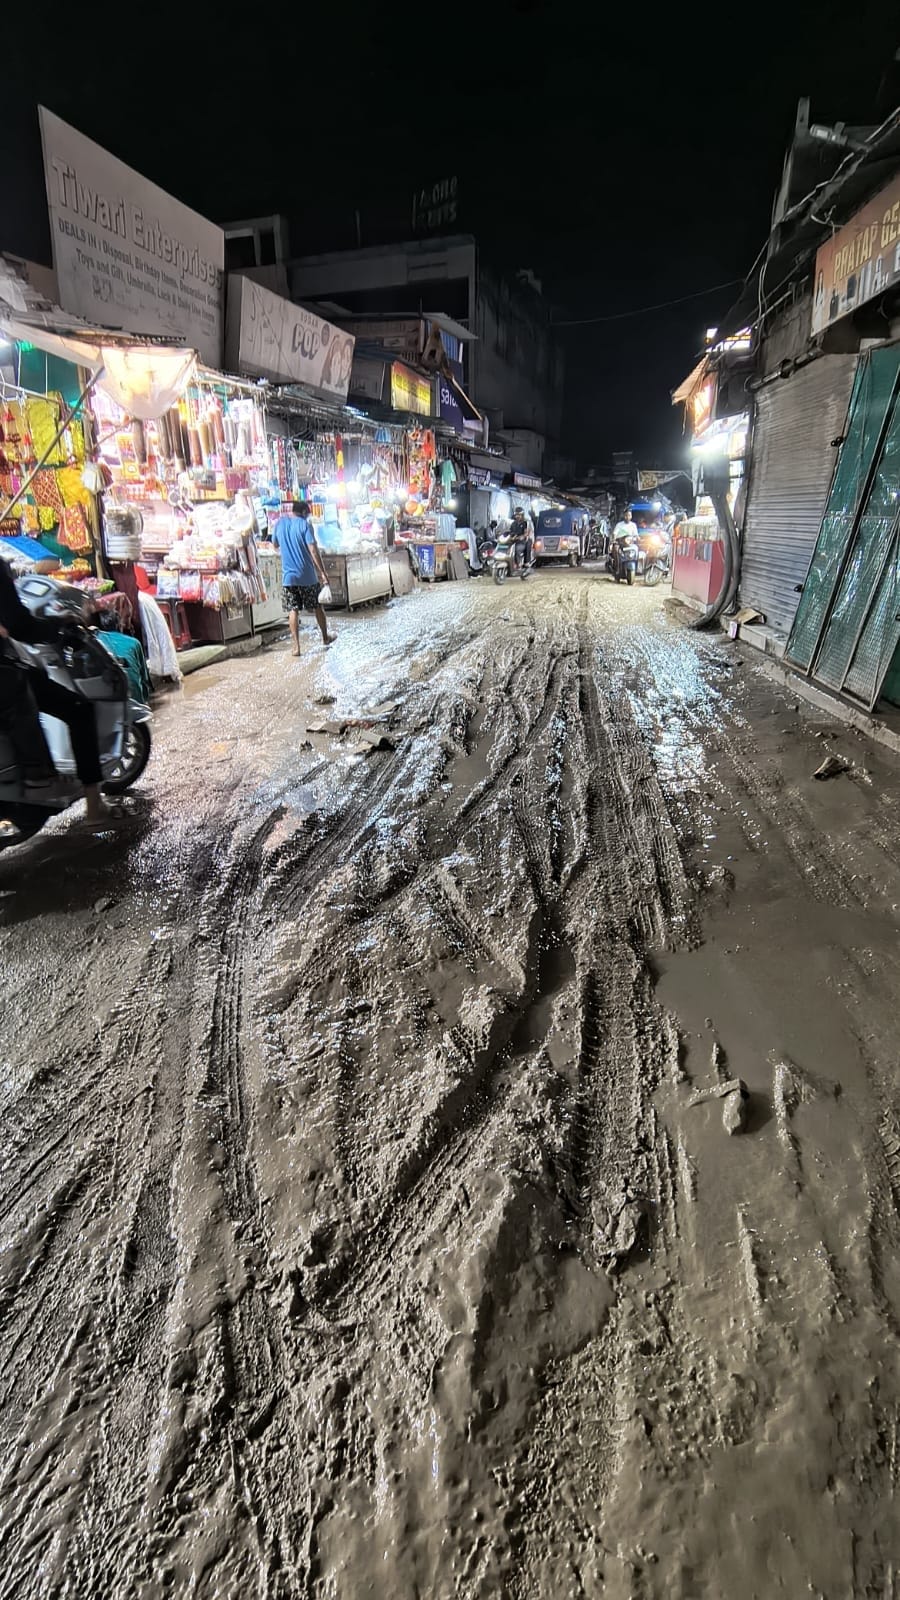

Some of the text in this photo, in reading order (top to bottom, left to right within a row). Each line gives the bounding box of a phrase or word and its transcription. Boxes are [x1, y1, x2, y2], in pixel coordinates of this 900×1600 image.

[51, 157, 222, 290] Tiwari Enterprises
[58, 217, 86, 242] DEALS
[87, 231, 97, 249] IN
[76, 247, 95, 271] Toys
[96, 260, 109, 276] and
[832, 200, 900, 286] PRATAP GE
[291, 323, 321, 361] POP
